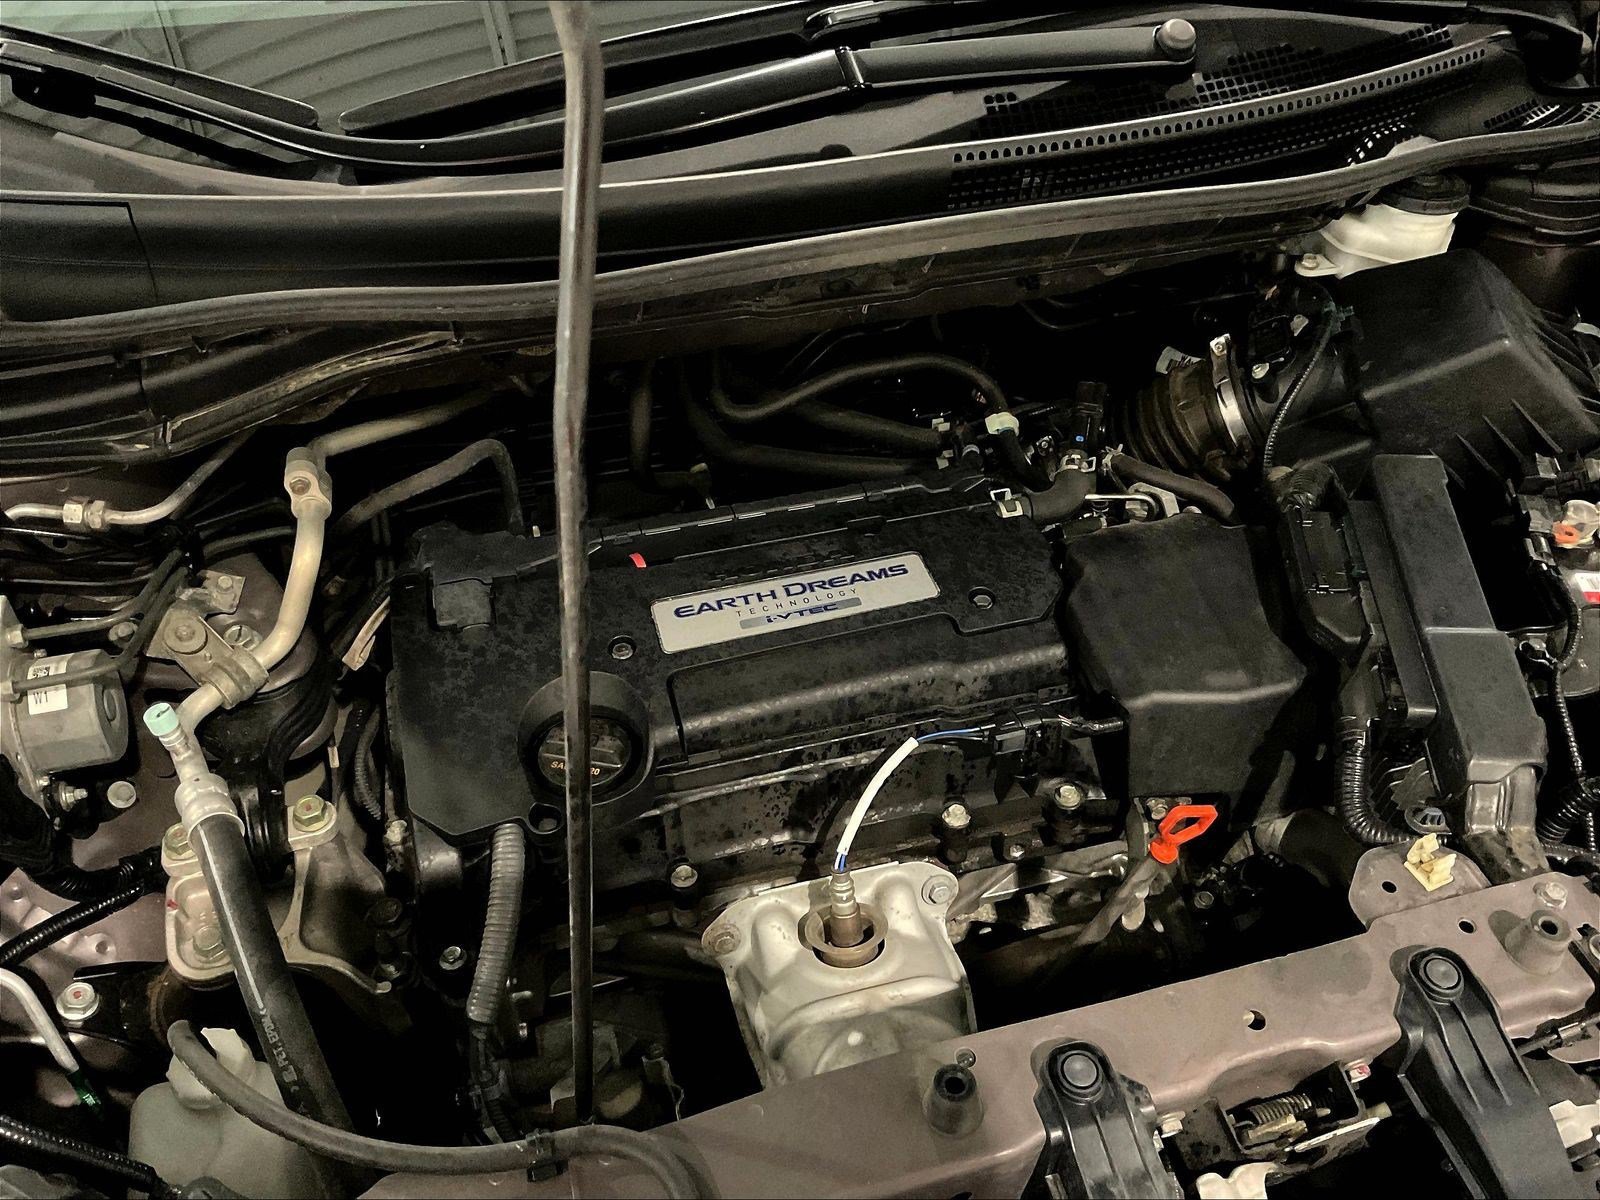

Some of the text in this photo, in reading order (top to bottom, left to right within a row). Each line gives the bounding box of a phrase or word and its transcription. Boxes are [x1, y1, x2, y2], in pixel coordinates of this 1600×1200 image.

[673, 589, 778, 619] EARTH
[782, 563, 910, 597] DREAMS
[735, 587, 858, 618] TECHNOLOGY
[765, 602, 839, 624] i-VTEC
